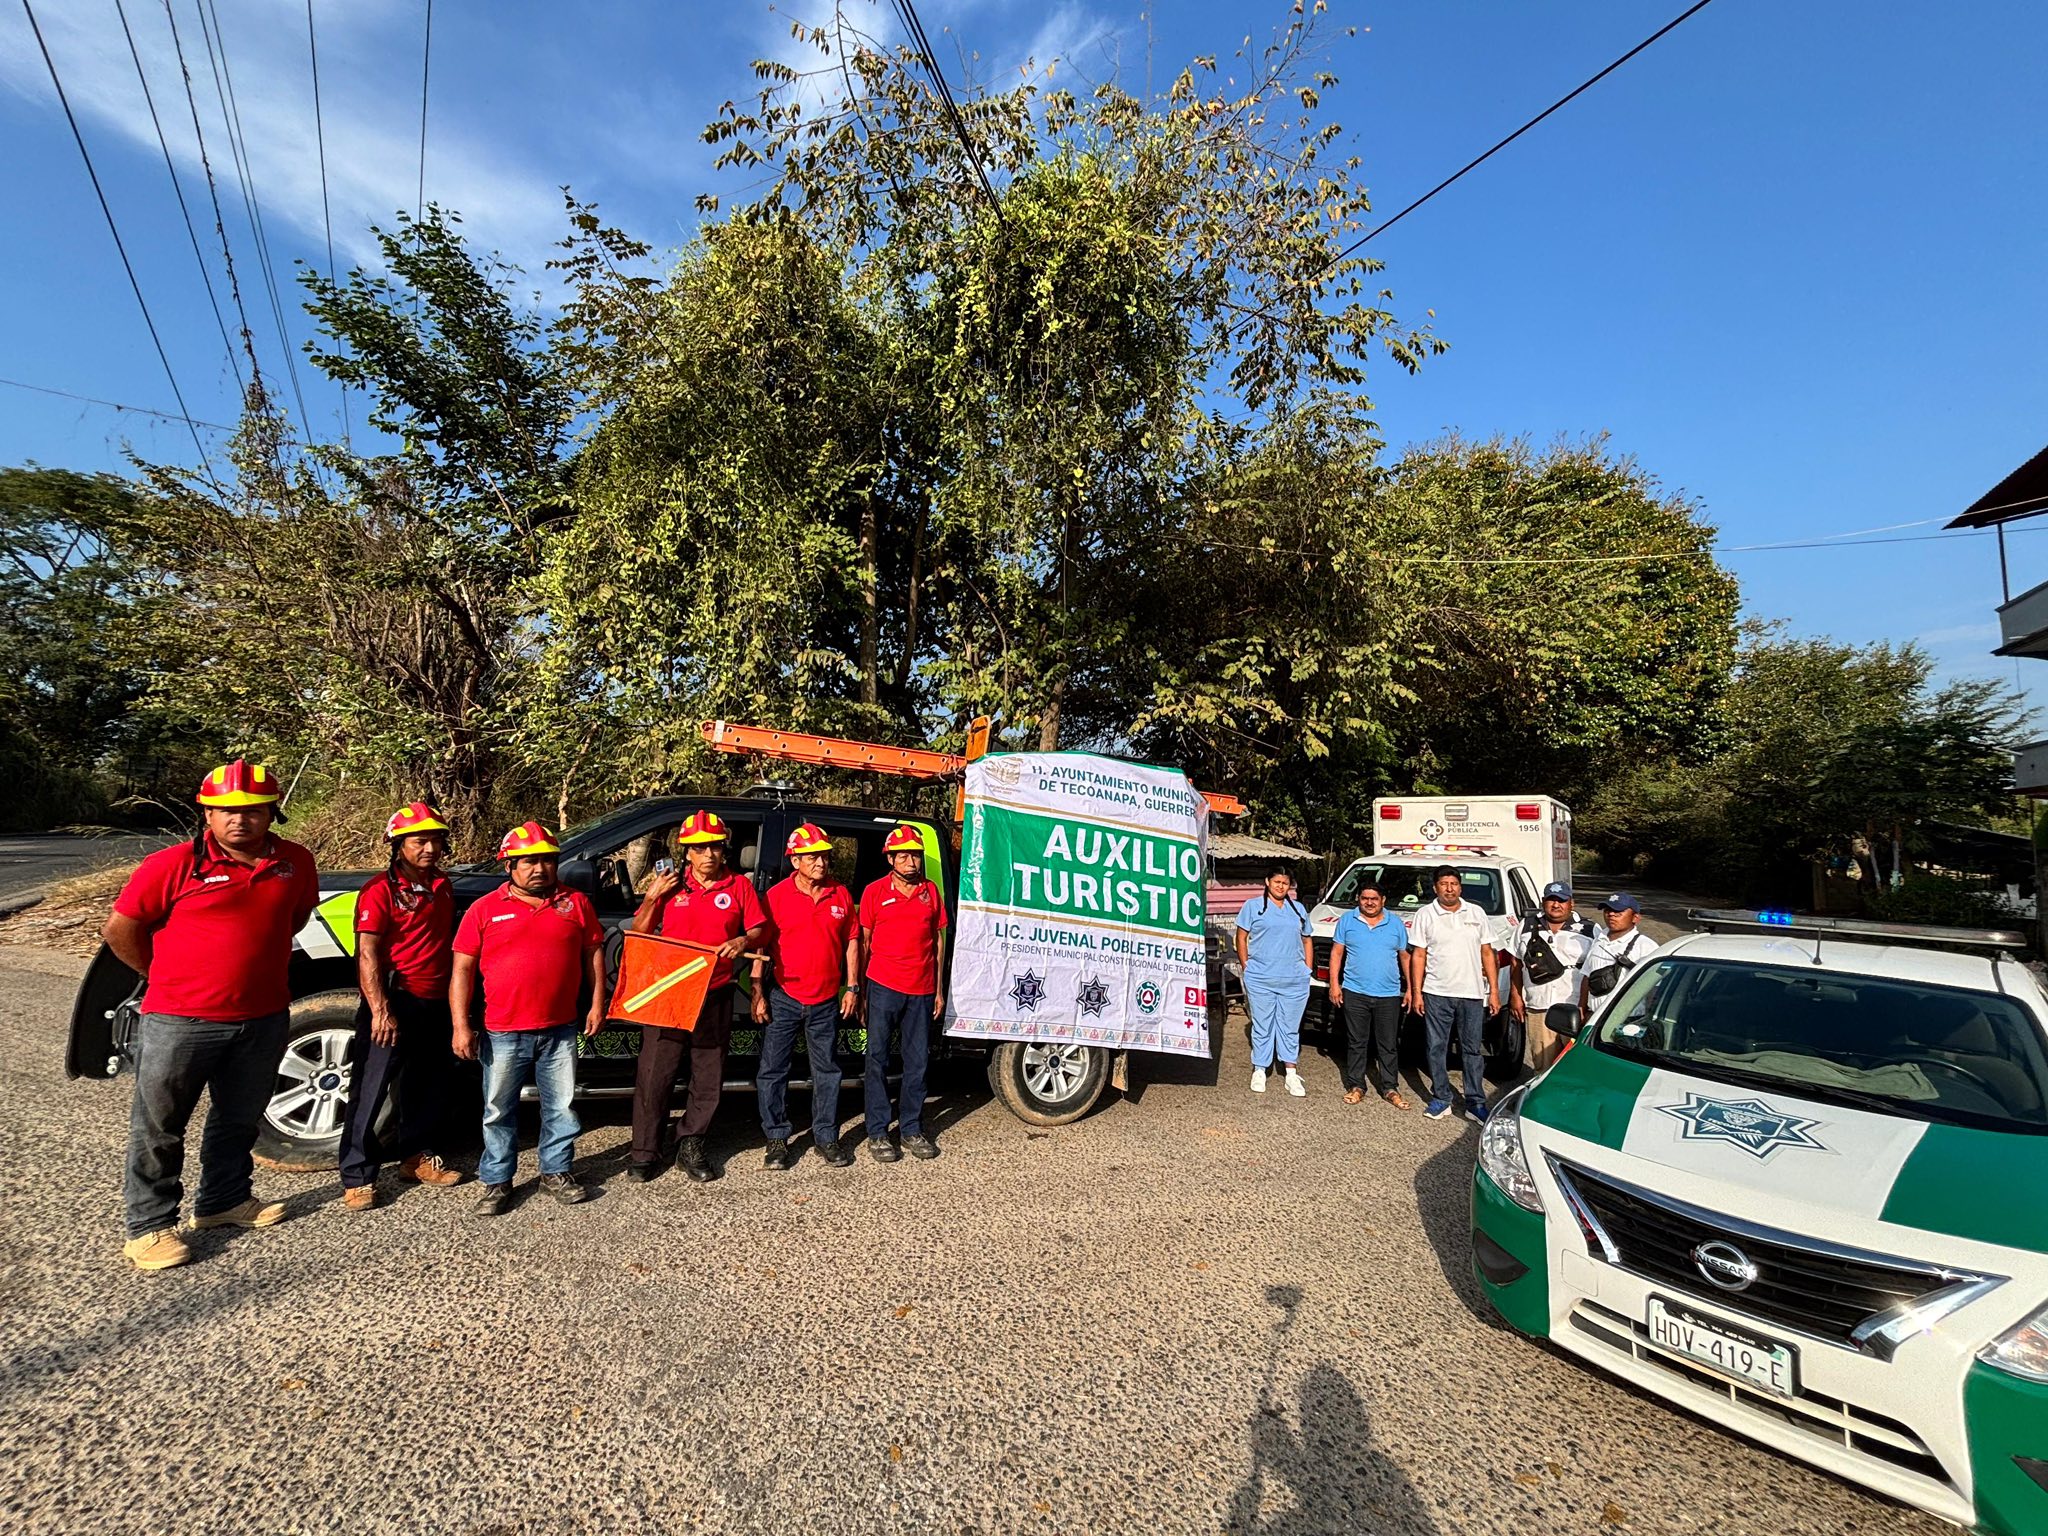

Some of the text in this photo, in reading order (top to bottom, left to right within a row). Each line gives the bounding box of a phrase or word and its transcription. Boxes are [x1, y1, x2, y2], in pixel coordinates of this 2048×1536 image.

[1039, 779, 1057, 792] DE
[1060, 781, 1141, 810] TECOANAPA,
[1050, 766, 1149, 794] AYUNTAMIENTO
[1519, 824, 1540, 832] 1956
[1042, 824, 1201, 883] AUXILIO
[1012, 862, 1202, 927] TURÍSTIC
[995, 922, 1024, 940] LIC.
[1029, 927, 1097, 949] JUVENAL
[1101, 936, 1163, 958] POBLETE
[1000, 942, 1052, 956] PRESIDENTE
[1053, 948, 1097, 962] MUNICIPAL
[1099, 954, 1164, 971] CONSTITUCIONAL
[1163, 963, 1173, 973] DE
[1695, 1252, 1749, 1277] NISSAN
[1654, 1315, 1786, 1390] HDV-419-E
